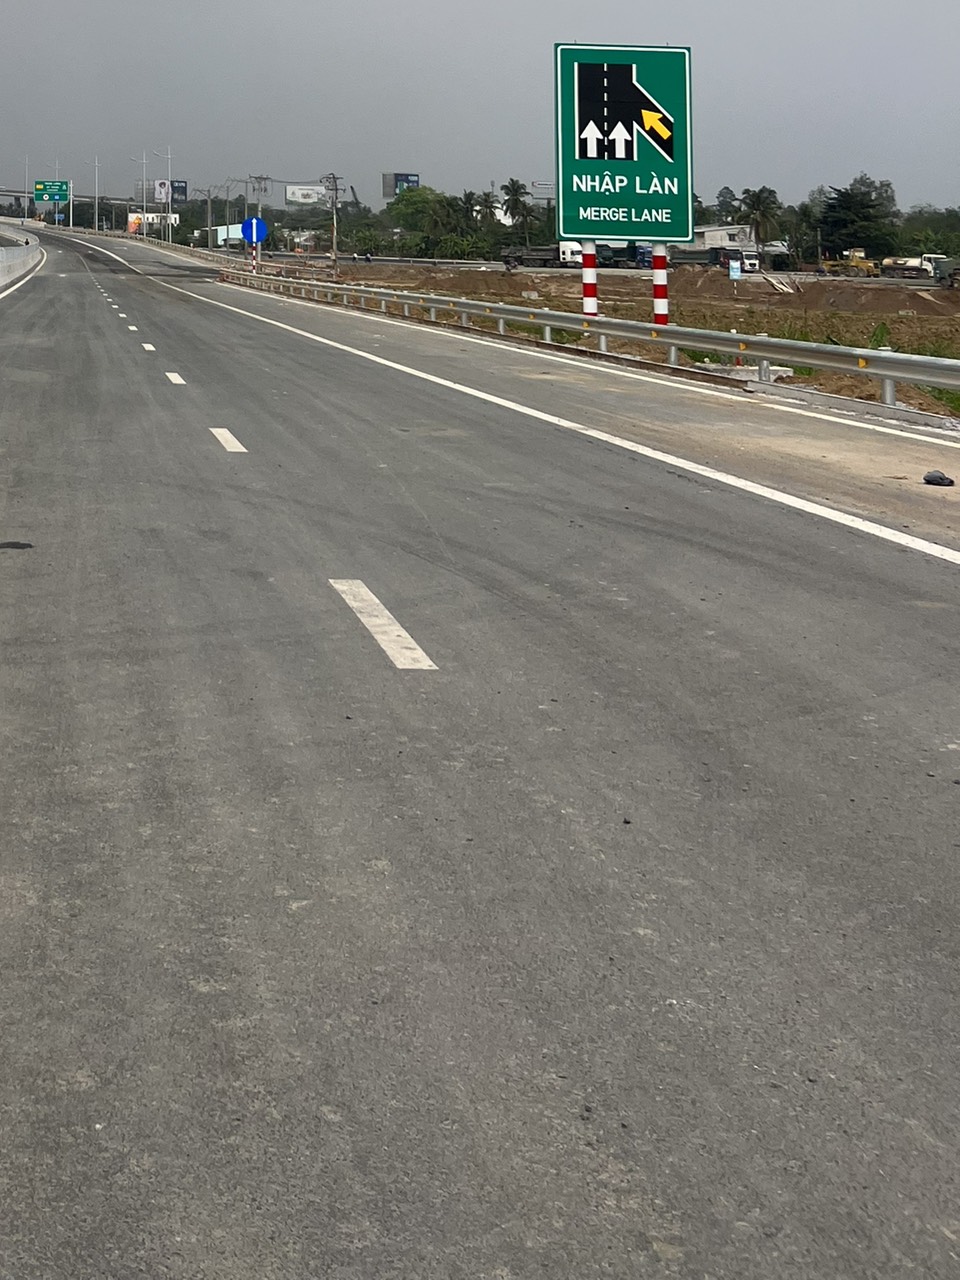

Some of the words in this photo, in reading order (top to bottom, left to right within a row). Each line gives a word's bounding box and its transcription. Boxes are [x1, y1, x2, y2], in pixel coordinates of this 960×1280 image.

[572, 171, 628, 195] NHẬP
[635, 171, 678, 195] LÀN
[579, 207, 628, 221] MERGE
[631, 208, 671, 222] LANE
